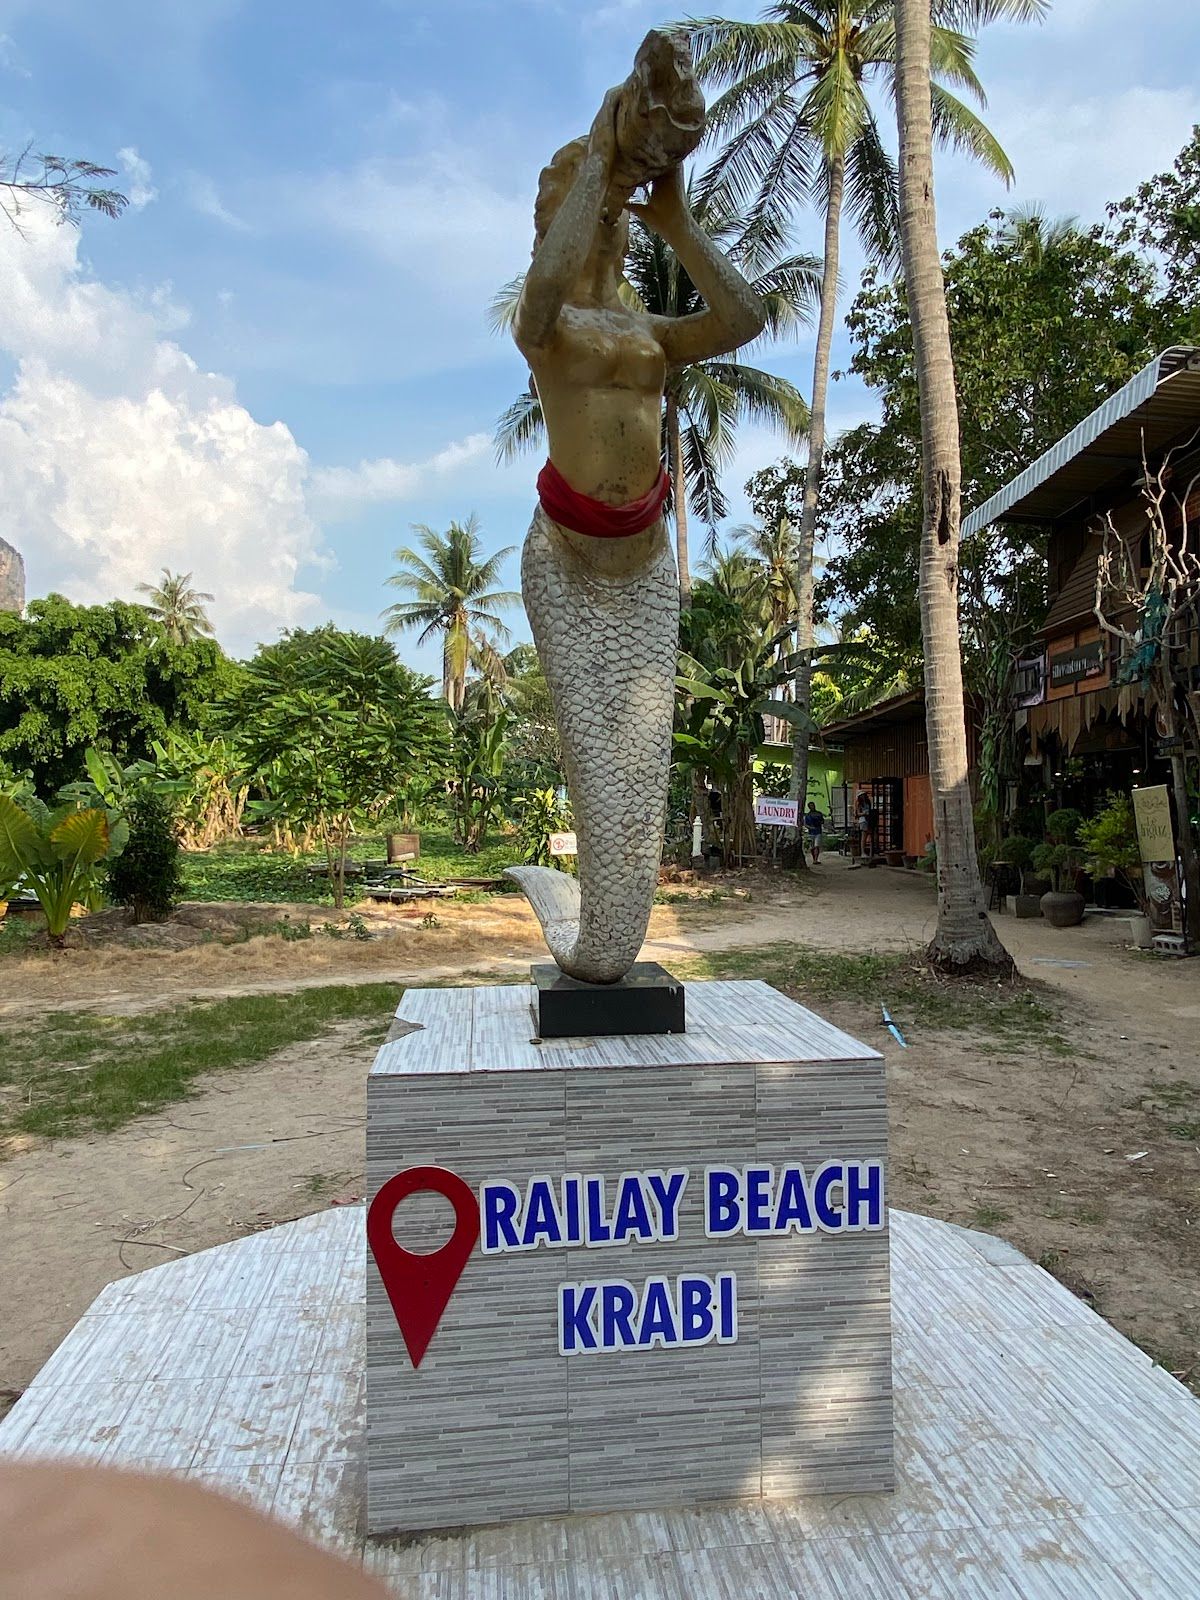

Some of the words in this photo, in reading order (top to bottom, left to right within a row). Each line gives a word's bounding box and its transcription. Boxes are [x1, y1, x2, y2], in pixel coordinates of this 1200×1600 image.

[757, 805, 796, 818] LAUNDRY
[484, 1173, 686, 1249] RAILAY
[708, 1165, 881, 1232] BEACH
[562, 1277, 734, 1350] KRABI
